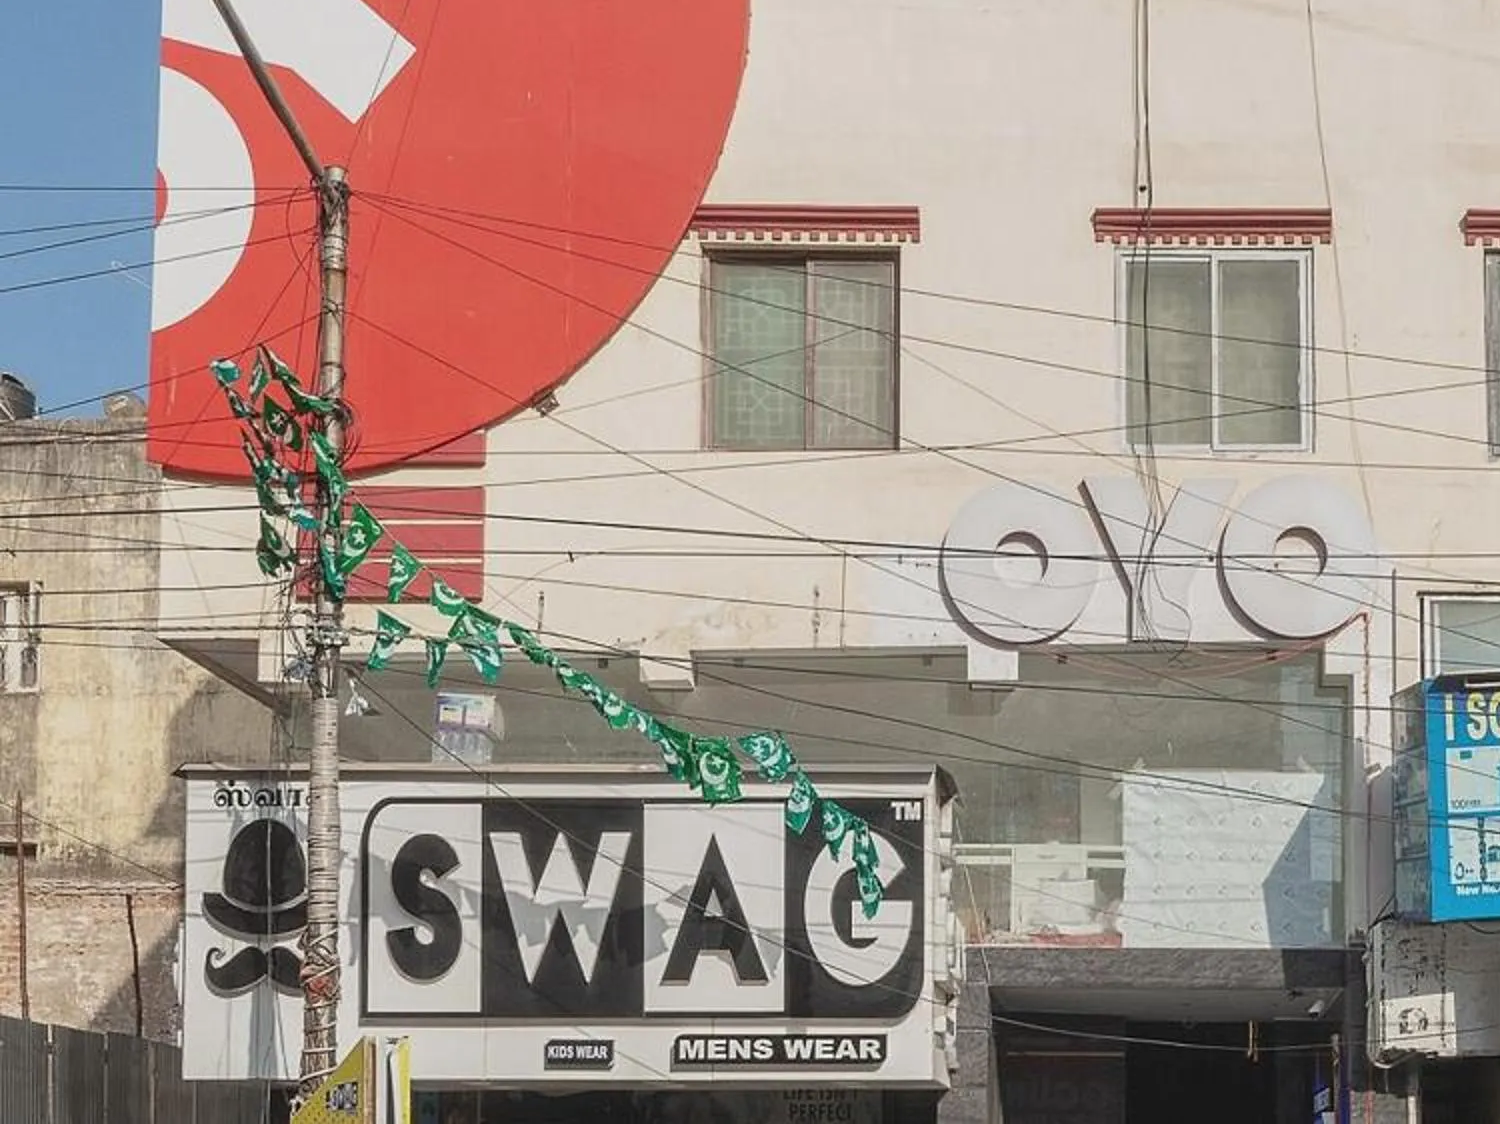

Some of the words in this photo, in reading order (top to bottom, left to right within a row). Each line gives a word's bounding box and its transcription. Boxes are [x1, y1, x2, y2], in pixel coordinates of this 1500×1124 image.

[937, 475, 1379, 652] OYO
[891, 802, 922, 821] TM
[384, 831, 914, 988] SWAG
[547, 1045, 575, 1059] KIDS
[575, 1045, 608, 1060] WEAR
[678, 1038, 774, 1061] MENS
[783, 1038, 883, 1061] WEAR
